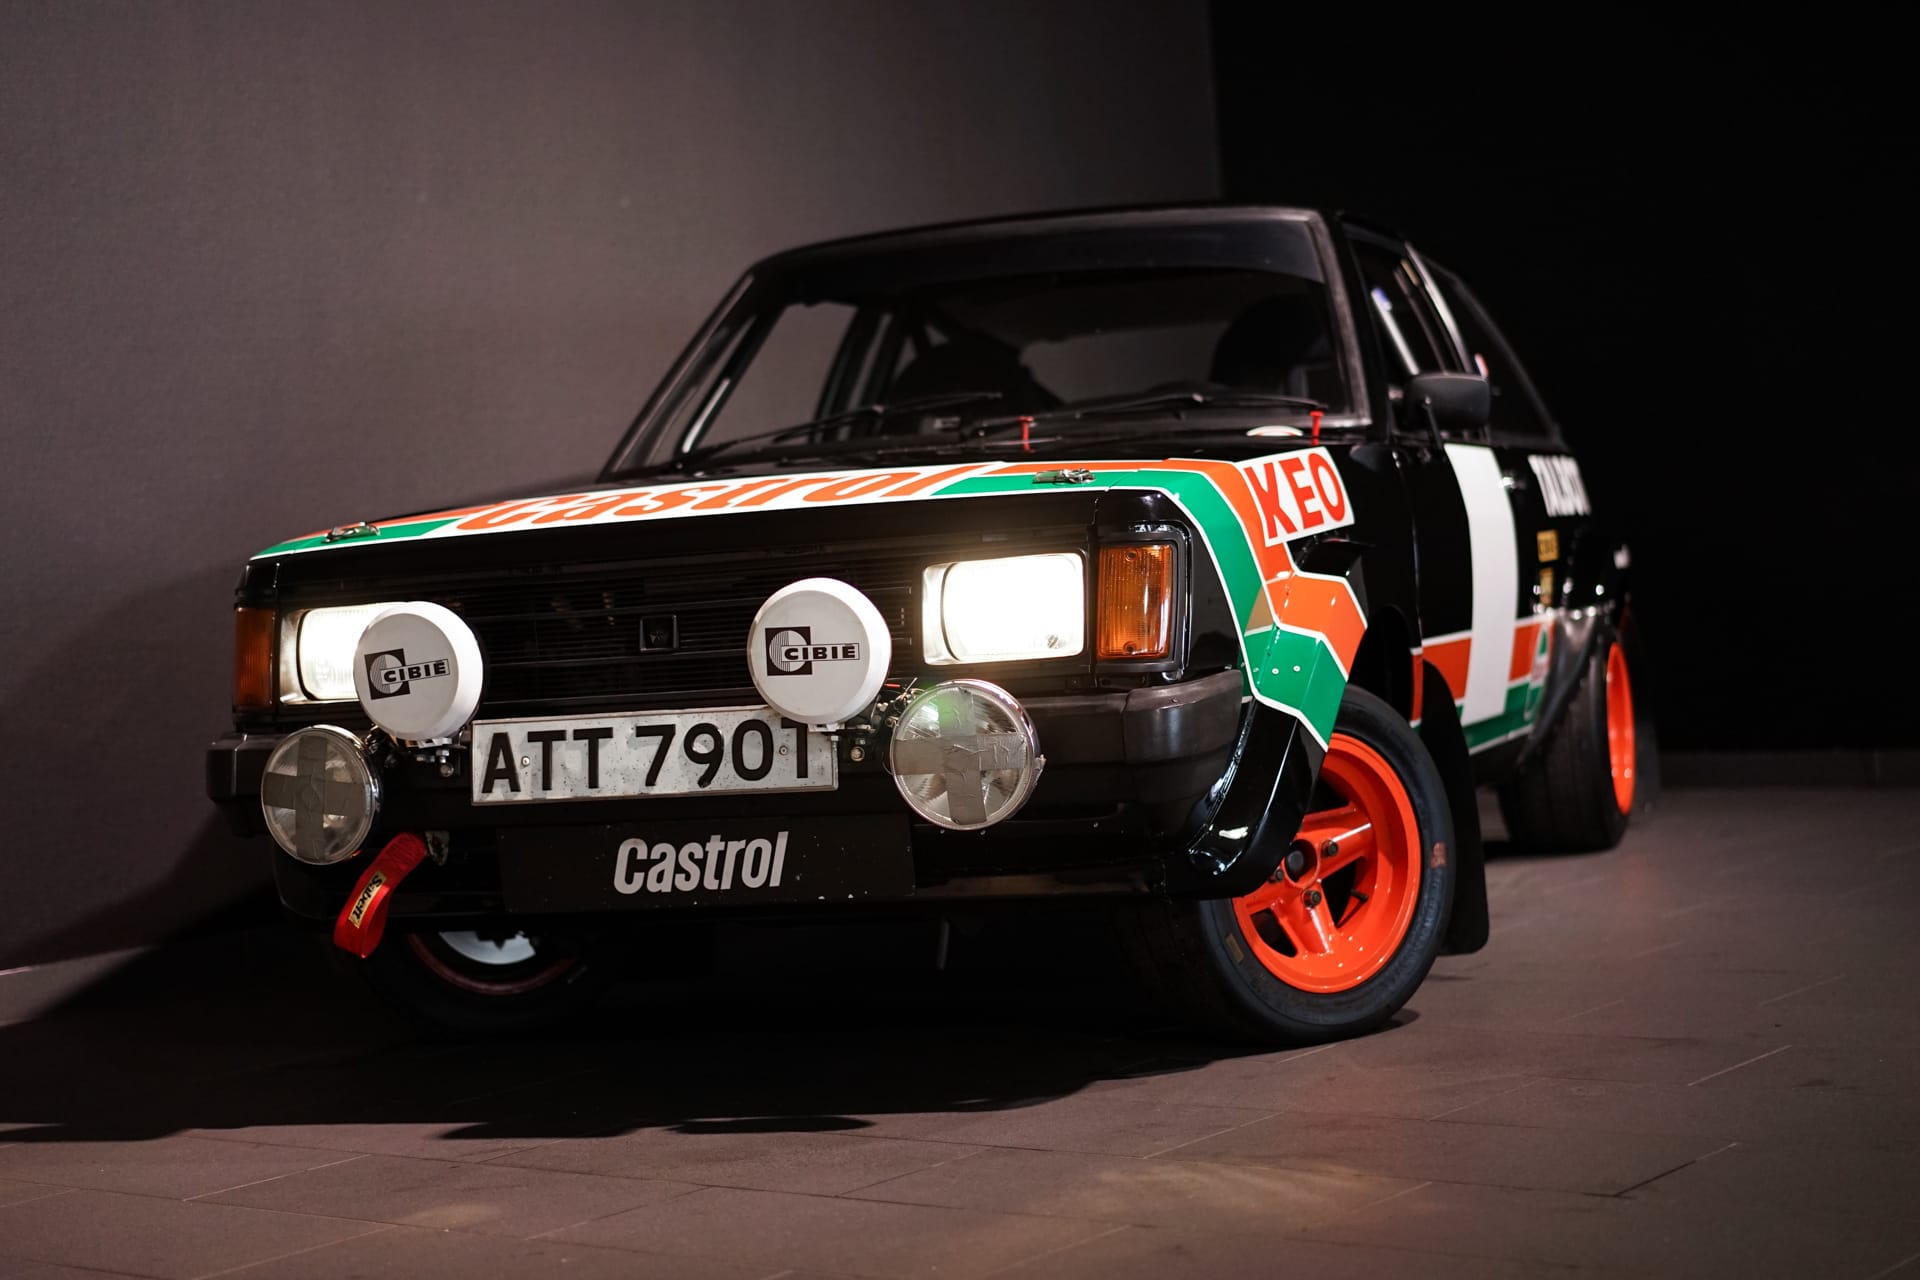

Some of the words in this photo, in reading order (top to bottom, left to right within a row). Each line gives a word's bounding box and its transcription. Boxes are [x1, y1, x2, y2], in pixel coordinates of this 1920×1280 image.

[456, 463, 995, 531] Castrol
[1243, 453, 1345, 539] KEO
[482, 726, 613, 794] ATT
[635, 718, 809, 788] 7901
[613, 831, 789, 895] Castrol
